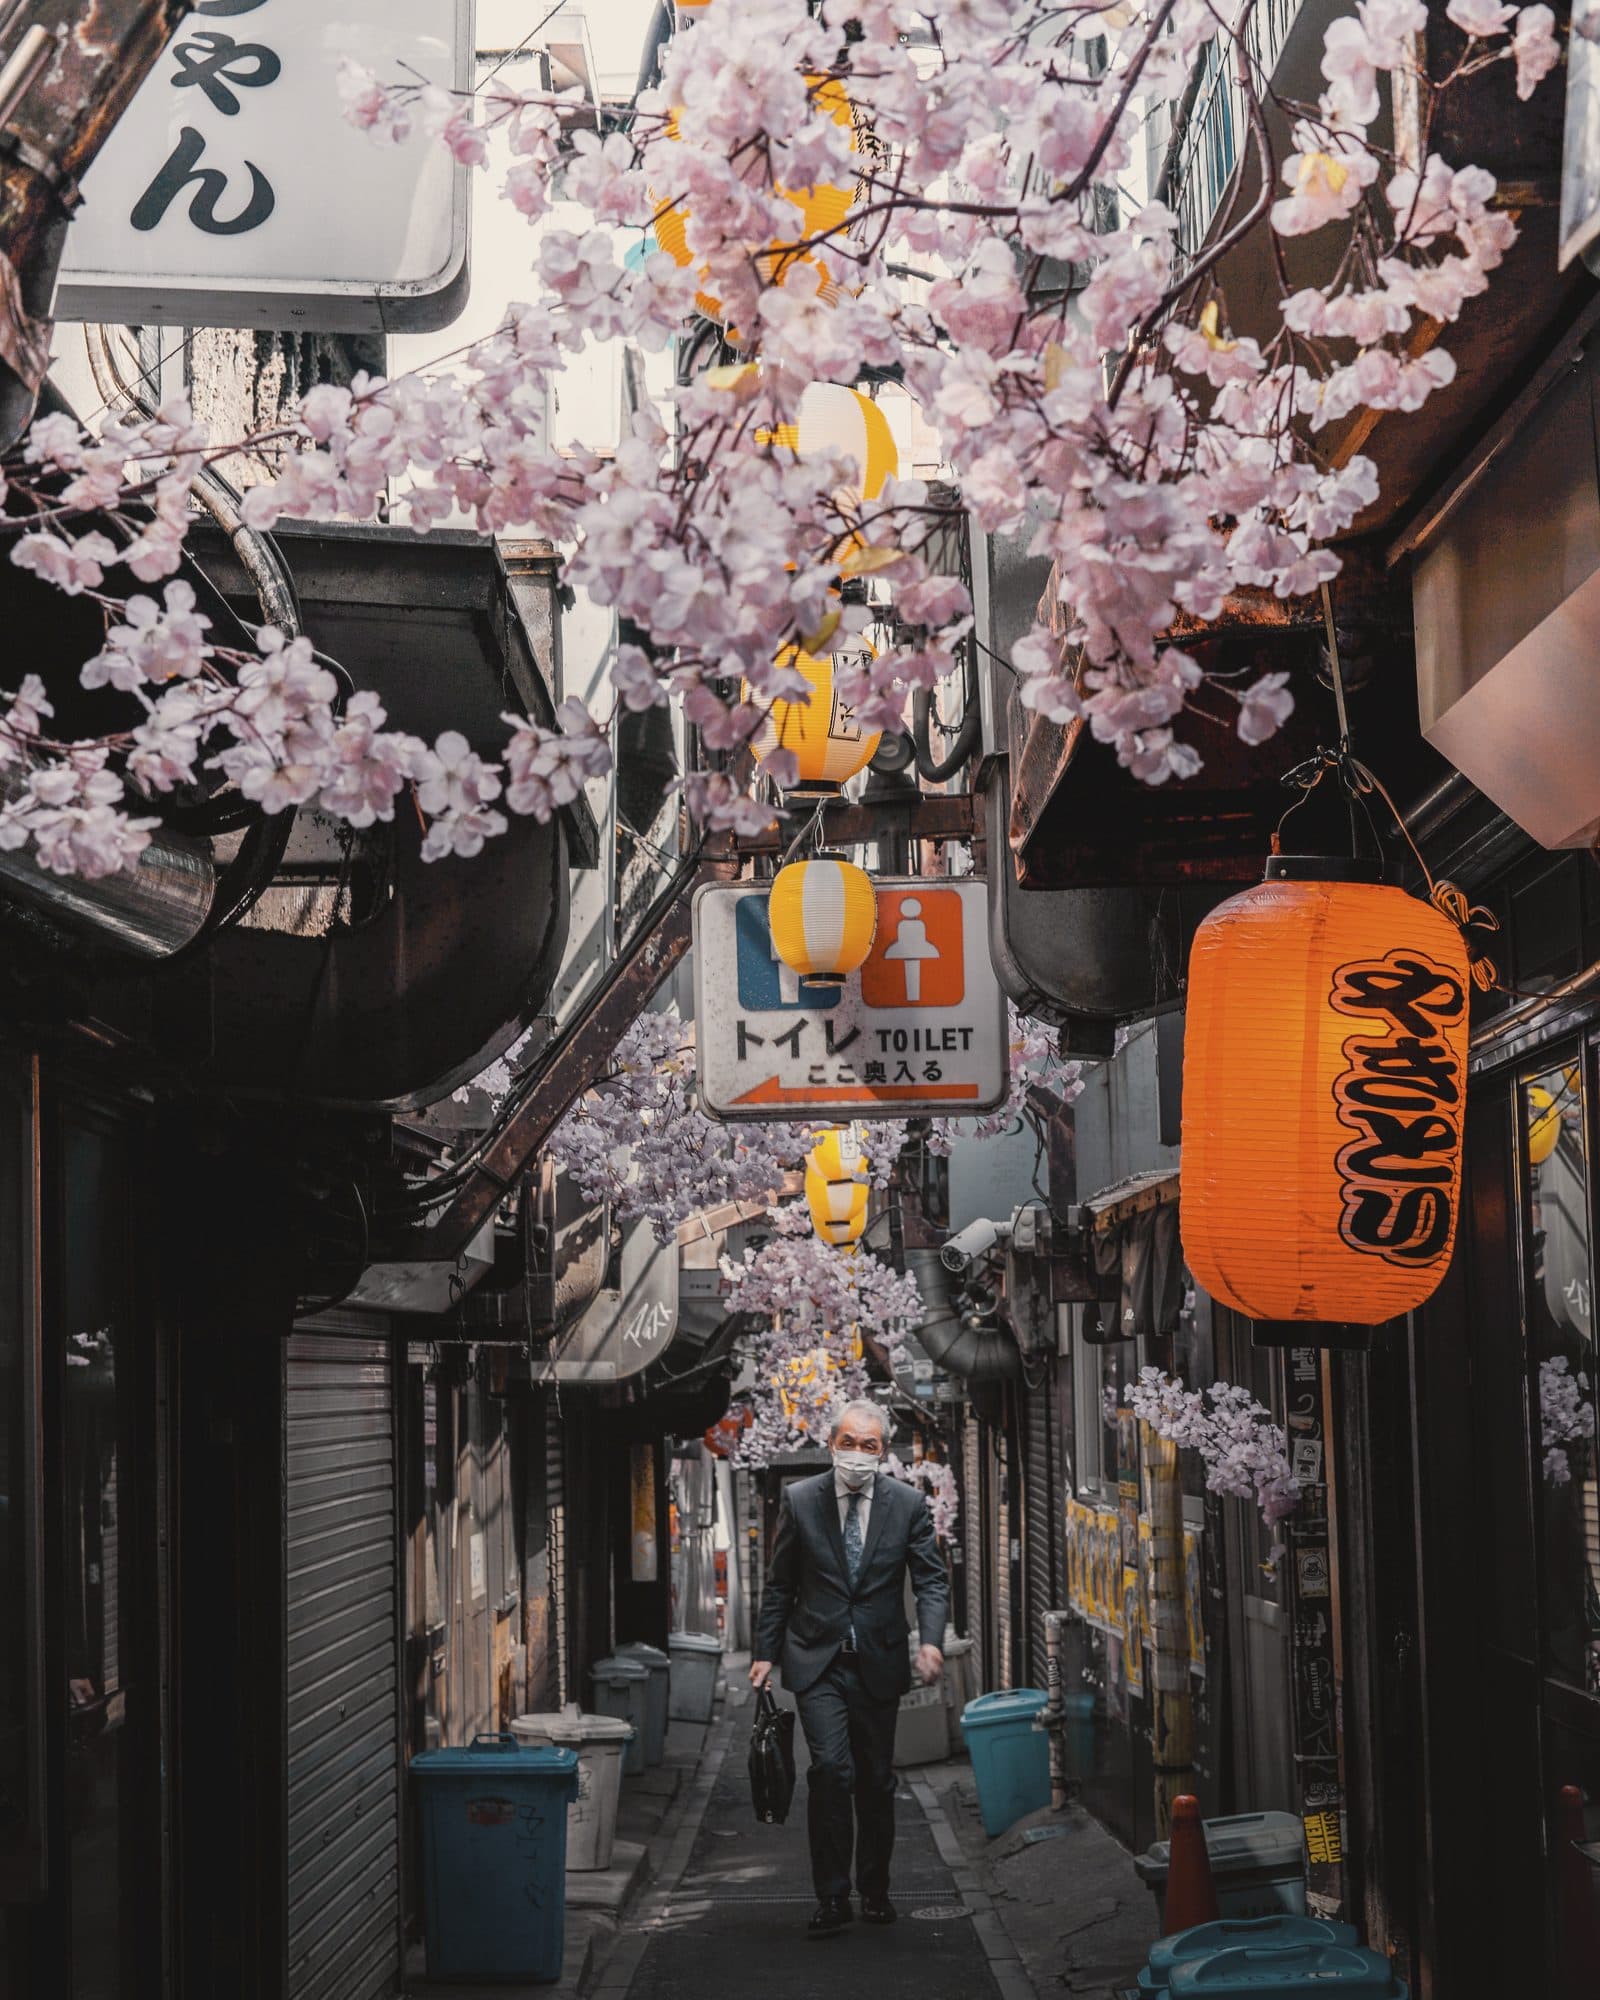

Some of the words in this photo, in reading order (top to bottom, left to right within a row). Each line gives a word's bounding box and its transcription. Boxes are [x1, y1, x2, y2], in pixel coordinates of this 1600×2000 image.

[737, 1018, 860, 1061] トイレ
[876, 1028, 974, 1053] TOILET
[808, 1060, 943, 1083] ここ奥入る
[1341, 957, 1466, 1259] やきとり
